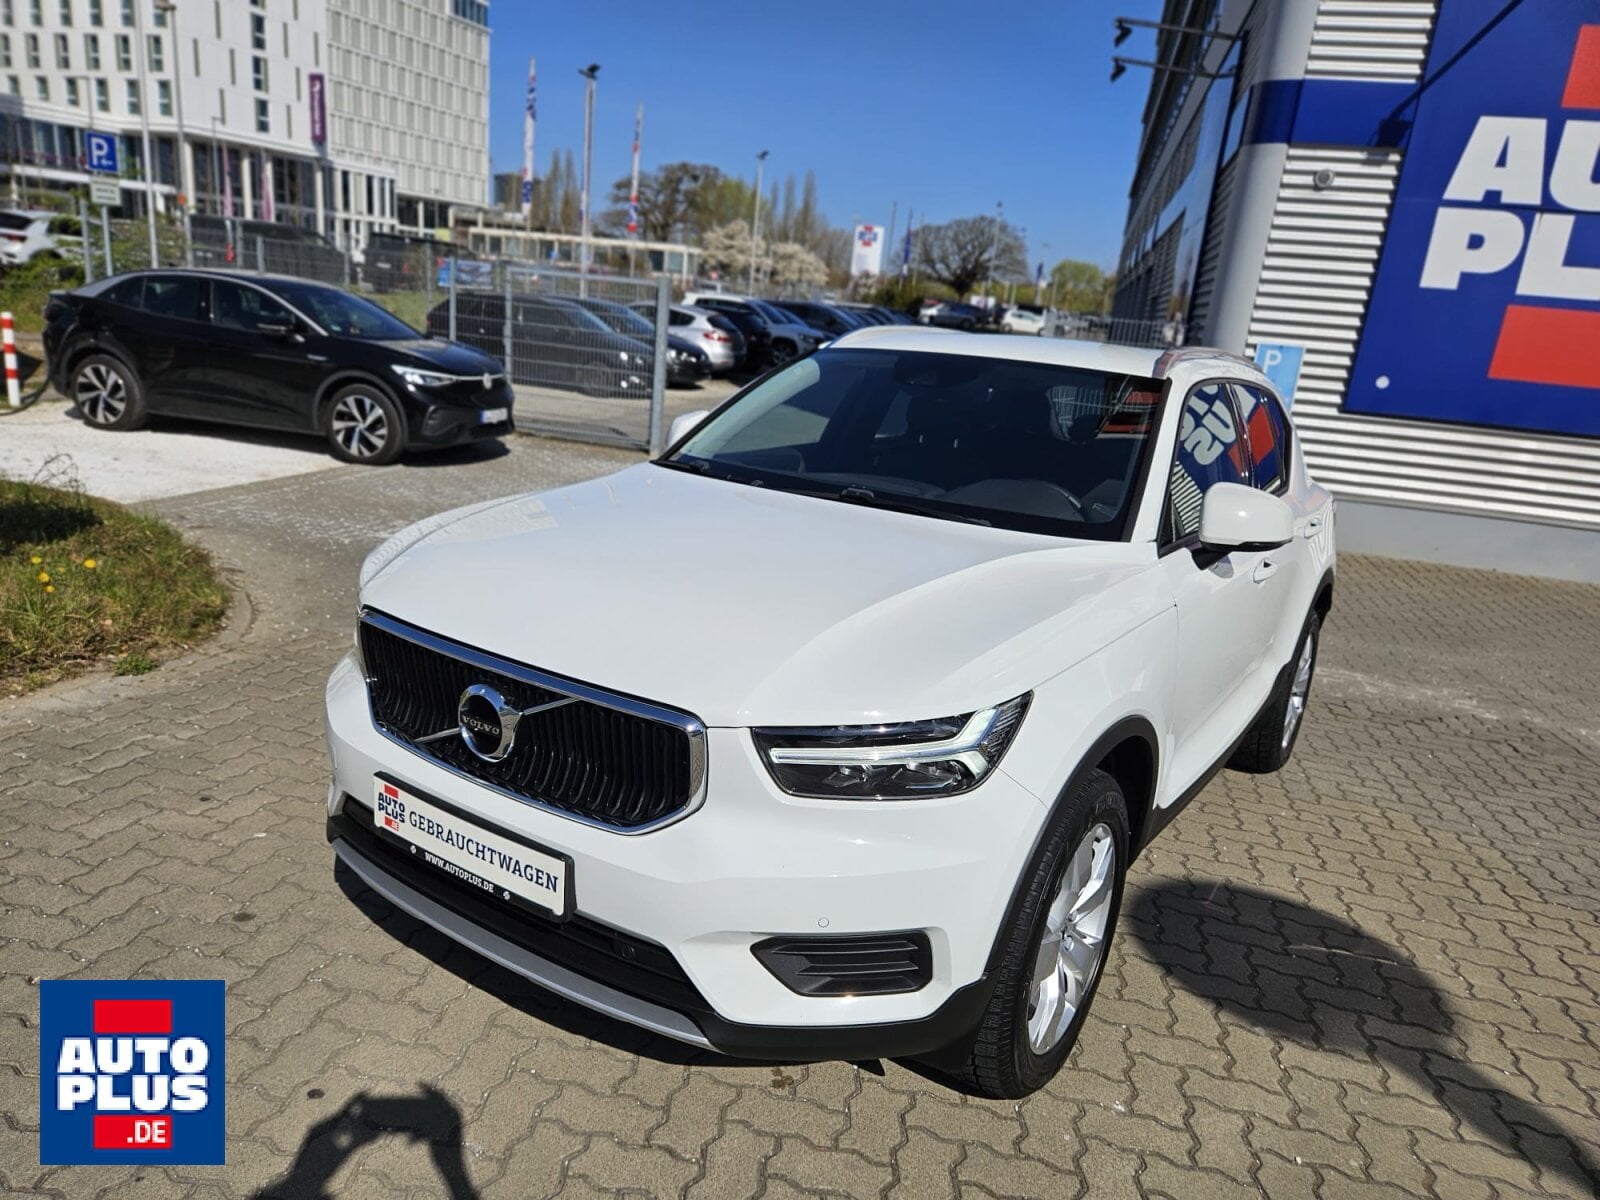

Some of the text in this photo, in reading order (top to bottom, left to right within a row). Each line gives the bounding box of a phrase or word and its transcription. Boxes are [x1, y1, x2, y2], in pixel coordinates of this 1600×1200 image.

[91, 137, 108, 166] P
[1263, 350, 1282, 374] P
[462, 715, 500, 735] VOLVO
[378, 792, 406, 813] AUTO
[378, 802, 406, 824] PLUS
[409, 811, 559, 893] GEBRAUCHTWAGEN
[424, 851, 495, 894] WWW.AUTOPLUS.DE
